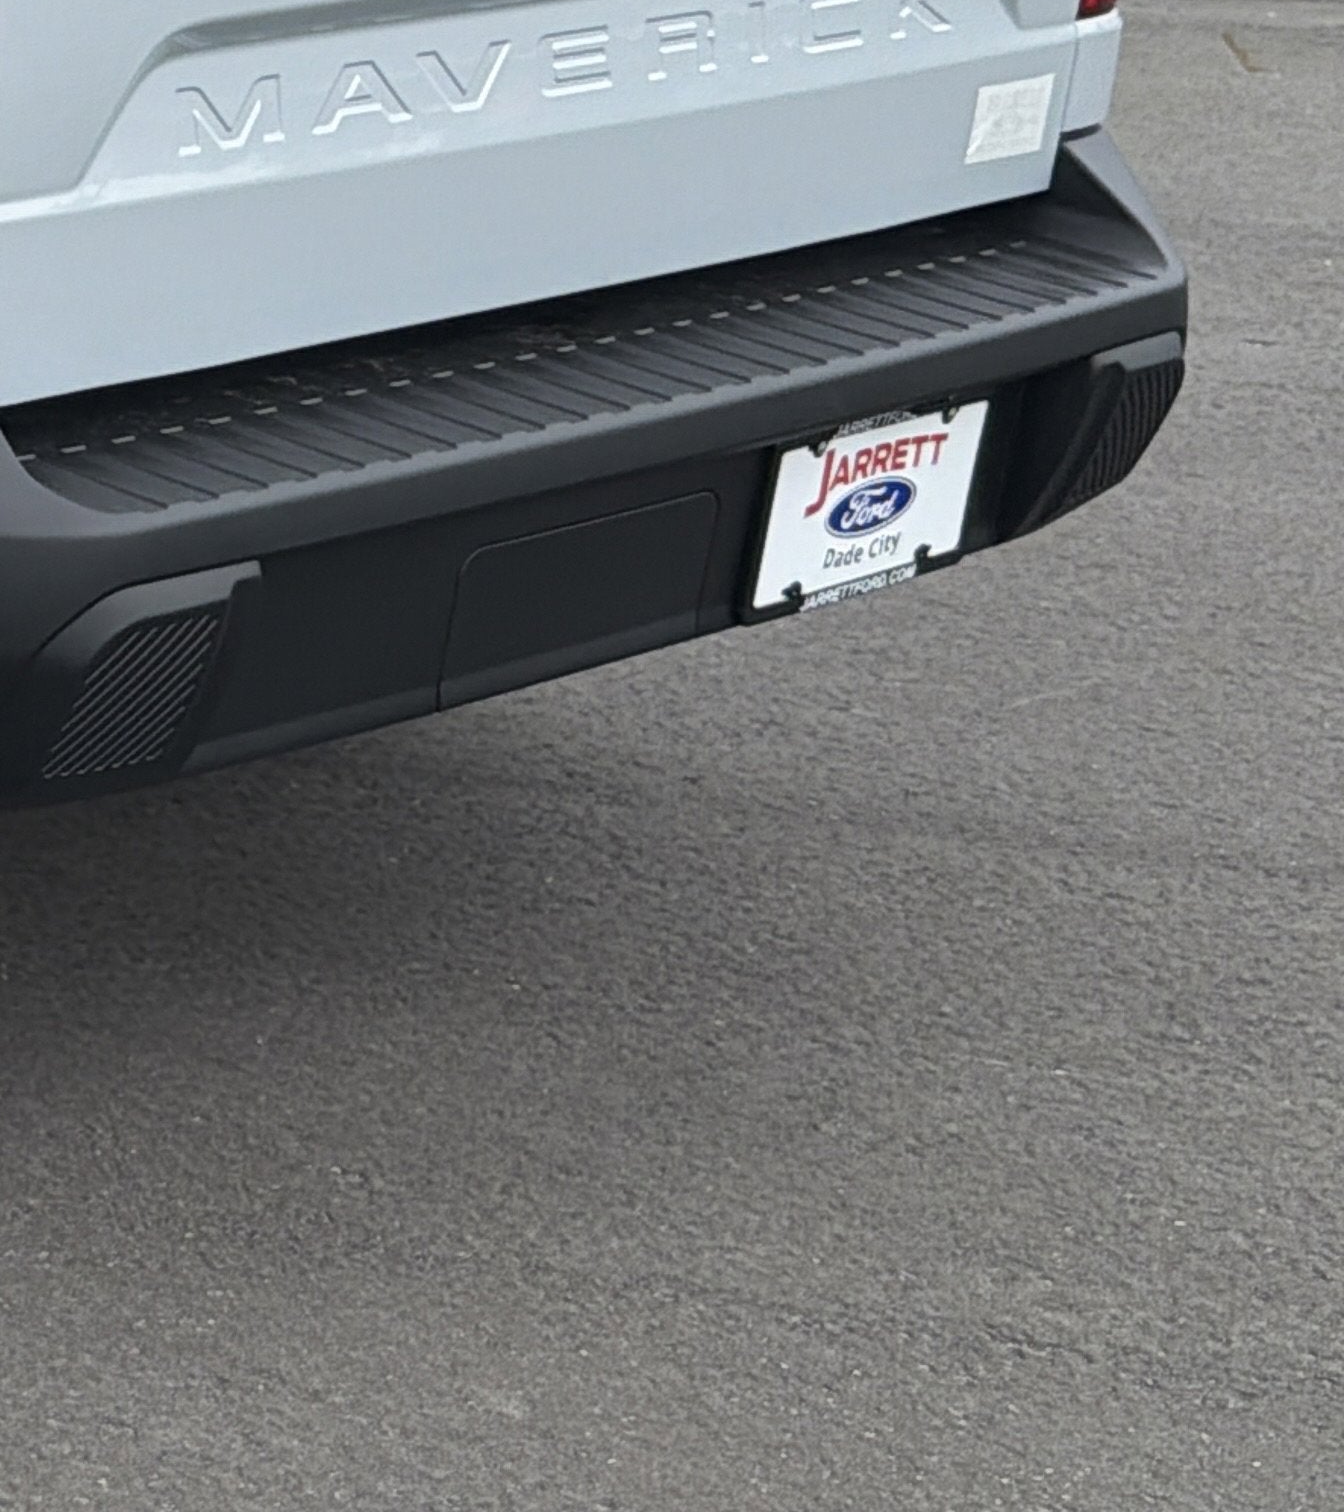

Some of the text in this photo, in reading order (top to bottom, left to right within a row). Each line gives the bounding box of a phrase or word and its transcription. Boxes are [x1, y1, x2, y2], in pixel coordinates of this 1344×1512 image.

[803, 432, 949, 518] JARRETT
[840, 486, 900, 530] Ford
[823, 531, 902, 569] Dade City
